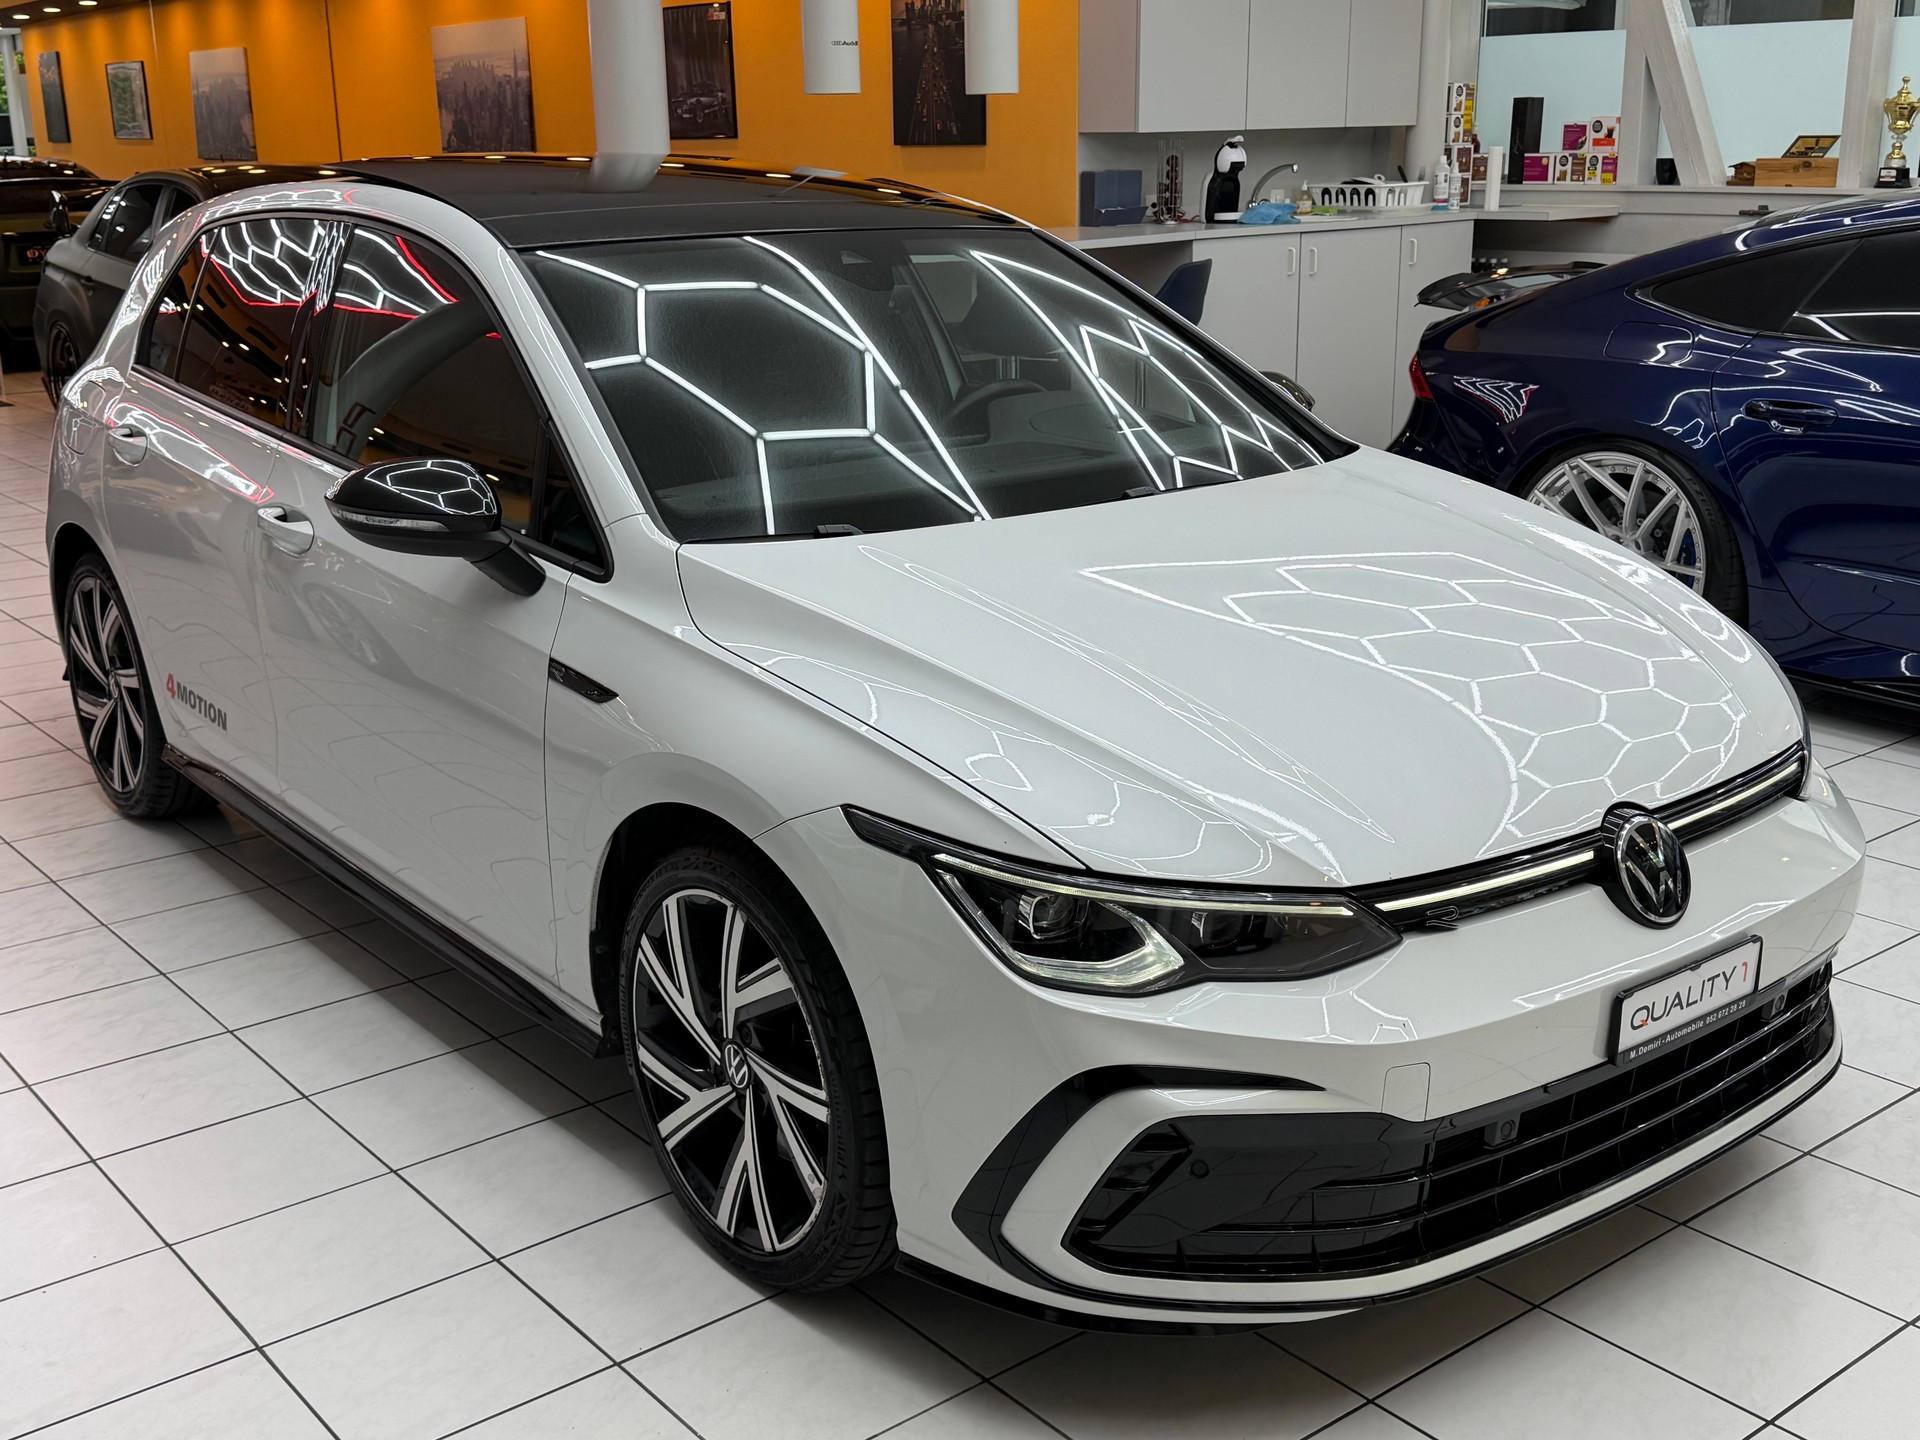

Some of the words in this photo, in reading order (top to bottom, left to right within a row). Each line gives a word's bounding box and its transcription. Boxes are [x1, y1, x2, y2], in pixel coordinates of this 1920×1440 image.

[166, 672, 228, 732] 4MOTION
[1630, 965, 1738, 1031] QUALITY
[1741, 960, 1749, 983] 1
[1638, 1037, 1662, 1056] Demiri
[1665, 1020, 1704, 1043] Automobile
